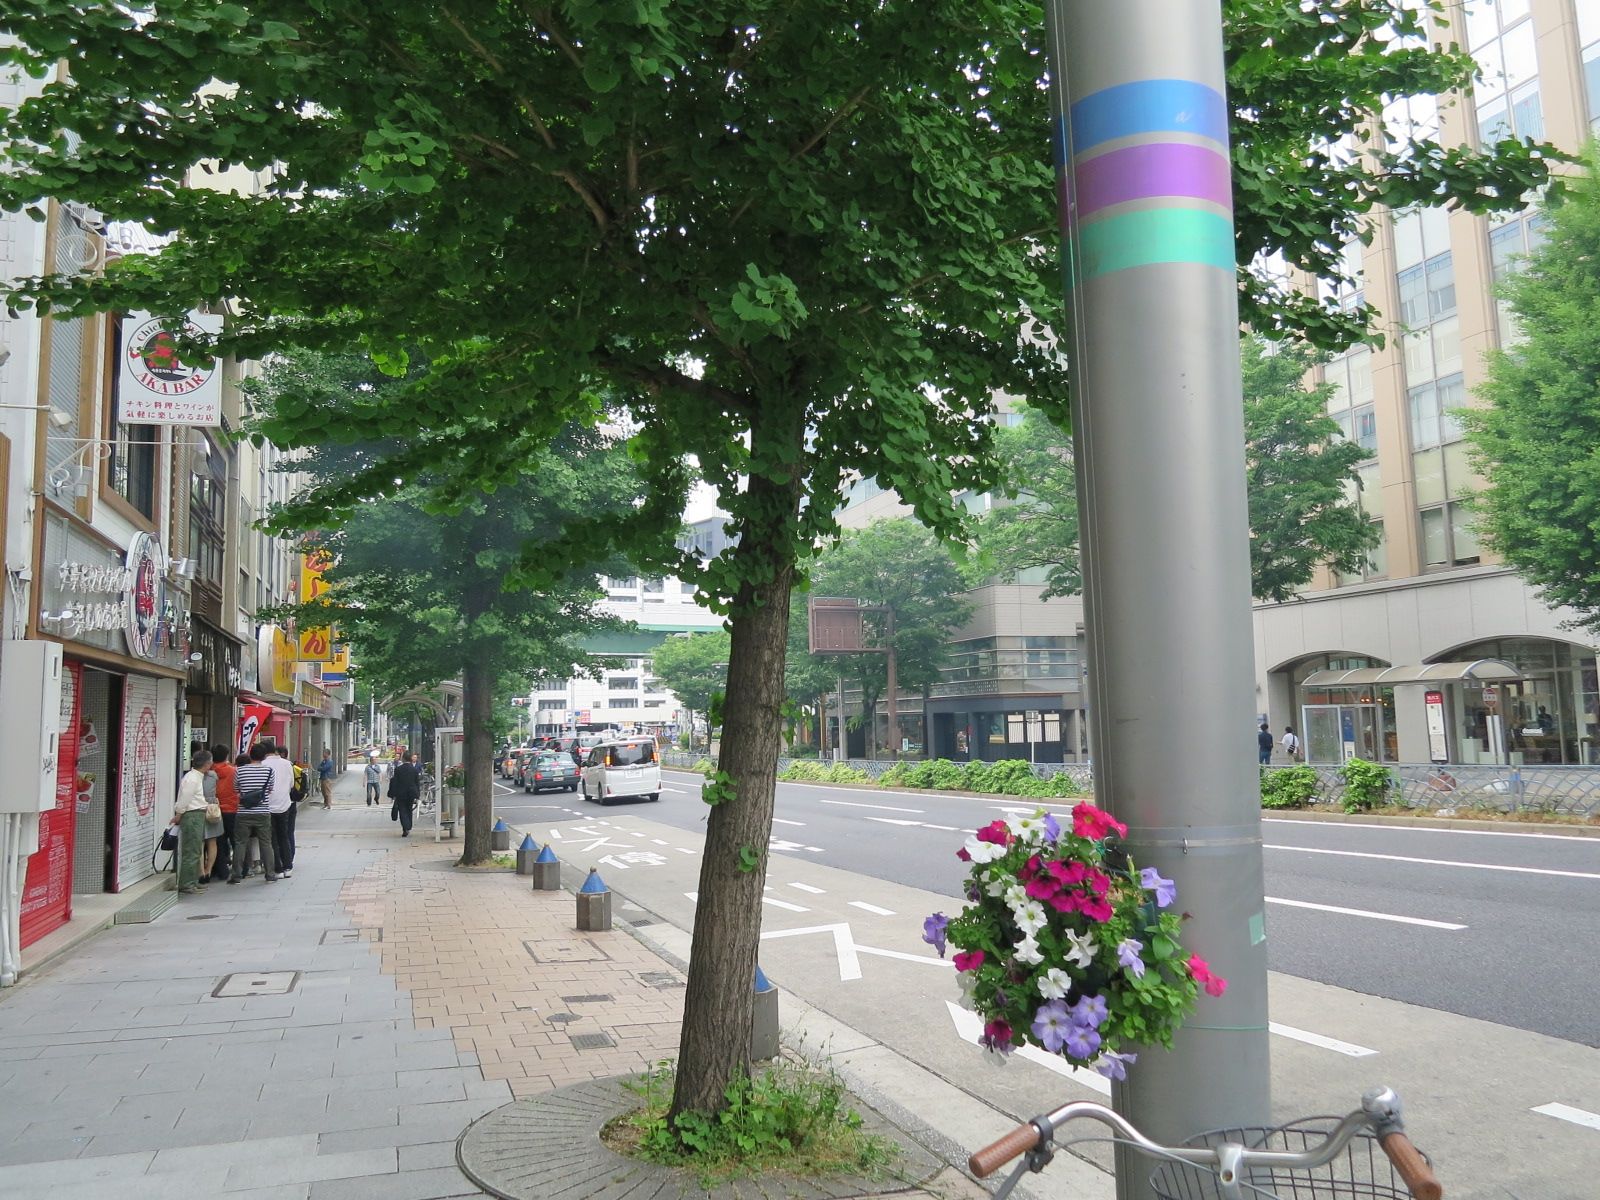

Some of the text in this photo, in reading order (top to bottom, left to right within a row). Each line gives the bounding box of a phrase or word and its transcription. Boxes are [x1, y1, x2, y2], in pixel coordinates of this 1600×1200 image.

[136, 372, 204, 394] AKA BAR
[126, 400, 214, 412] チキン料理とワインが
[126, 410, 214, 422] 気軽に楽しめるお店
